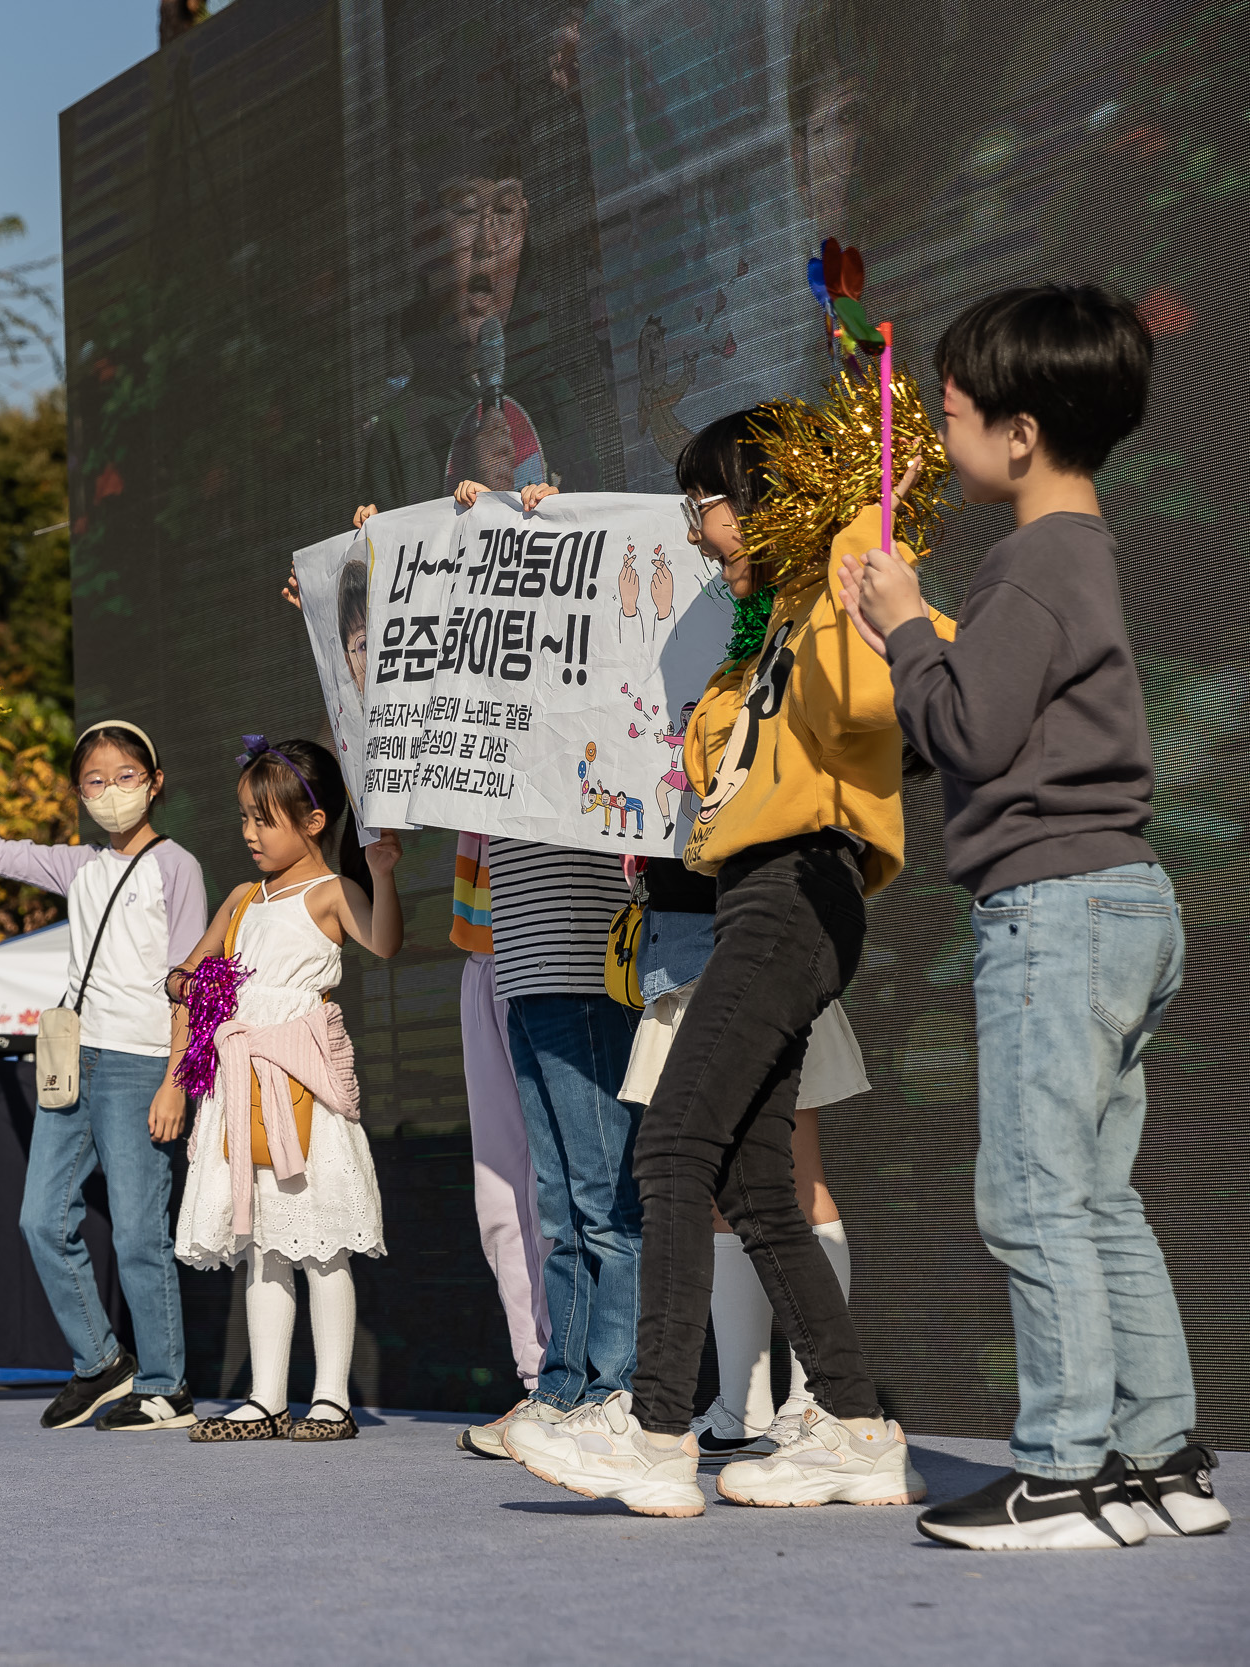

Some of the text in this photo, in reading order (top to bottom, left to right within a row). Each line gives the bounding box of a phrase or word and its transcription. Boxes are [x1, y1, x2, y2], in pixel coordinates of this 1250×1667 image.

[466, 527, 608, 601] 귀염둥이!
[462, 700, 503, 727] 노래도
[505, 703, 533, 731] 잘함
[459, 733, 477, 759] 꿈
[479, 735, 508, 764] 대상
[420, 763, 515, 799] #SM보고있나
